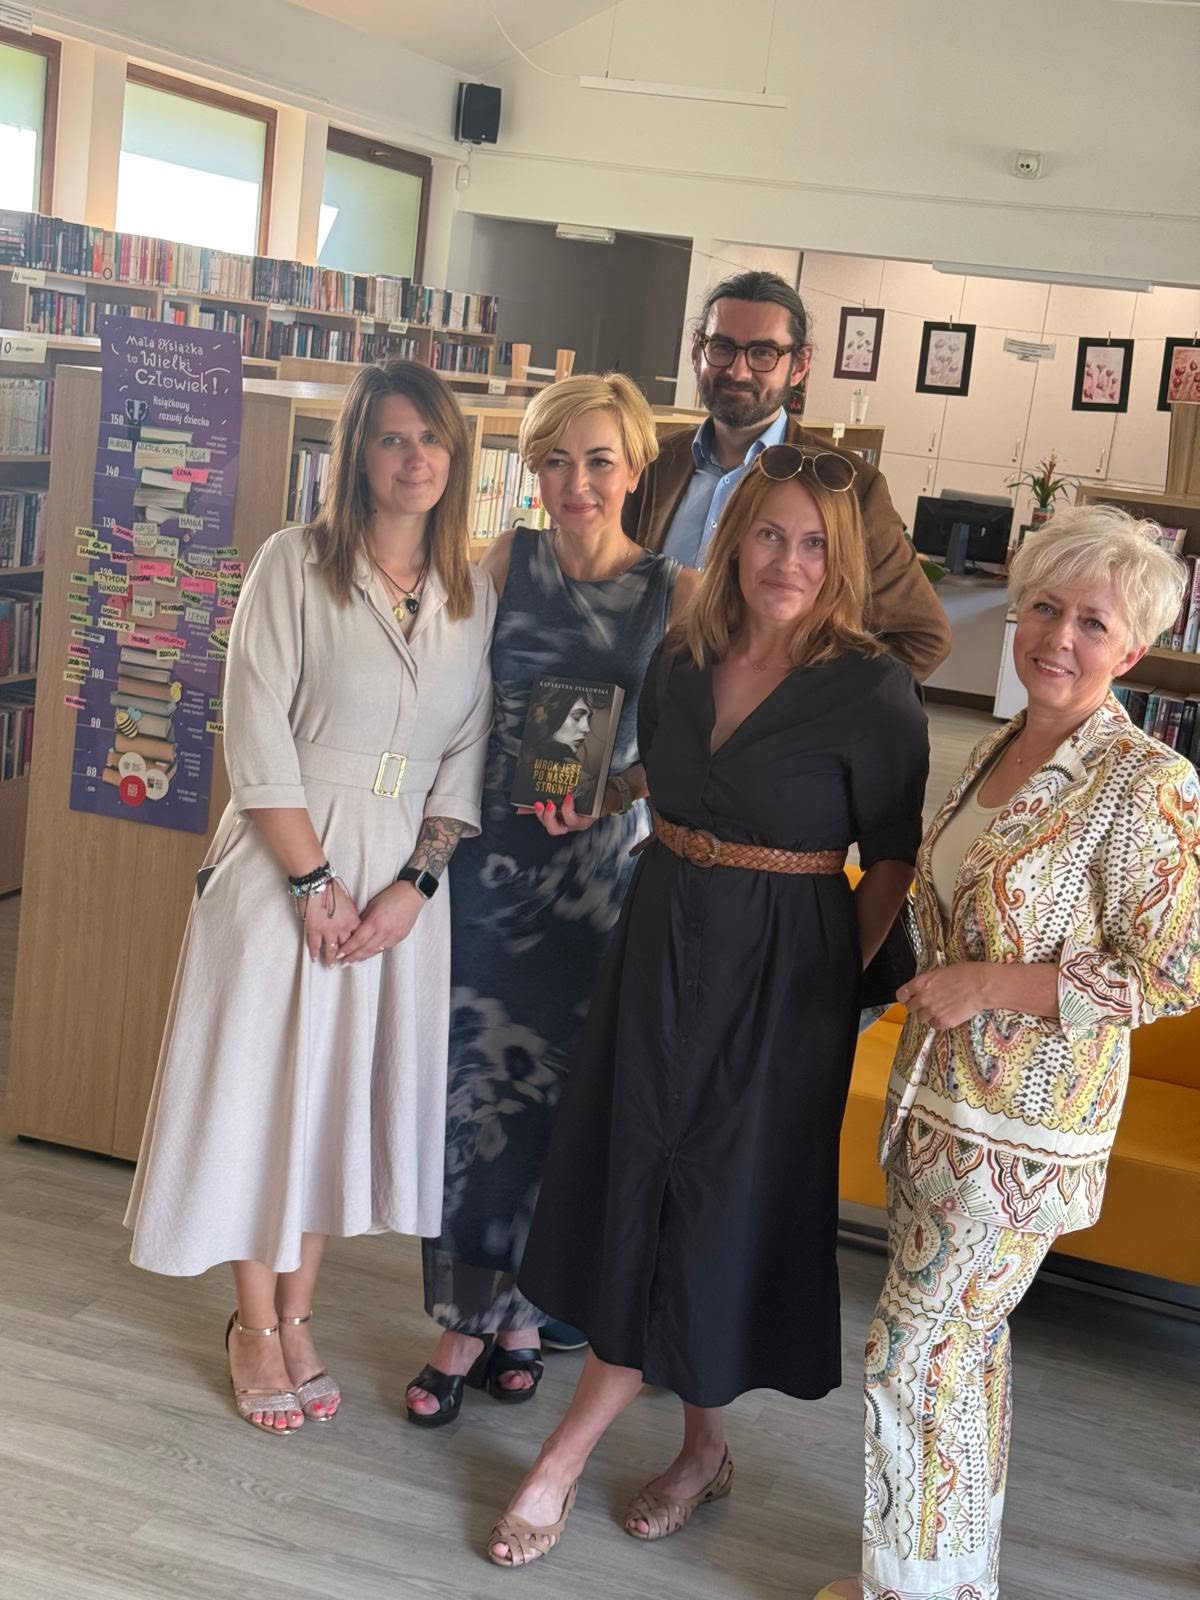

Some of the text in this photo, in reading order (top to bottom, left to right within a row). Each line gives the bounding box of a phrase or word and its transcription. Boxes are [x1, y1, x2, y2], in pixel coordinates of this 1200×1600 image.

[126, 335, 204, 356] Mała Książka
[126, 350, 196, 376] to Wielki
[153, 396, 191, 413] Książkowy
[111, 413, 125, 425] 150
[159, 411, 210, 427] rozwój dziecka
[105, 465, 120, 477] 140
[176, 469, 193, 477] LENA
[102, 516, 116, 528] 130
[98, 573, 127, 584] TYMON
[91, 668, 105, 679] 100
[90, 717, 101, 728] 90
[86, 767, 97, 778] 80
[534, 759, 582, 776] MROK JEST
[533, 770, 580, 787] PO NASZEJ
[535, 781, 573, 796] STRONIE
